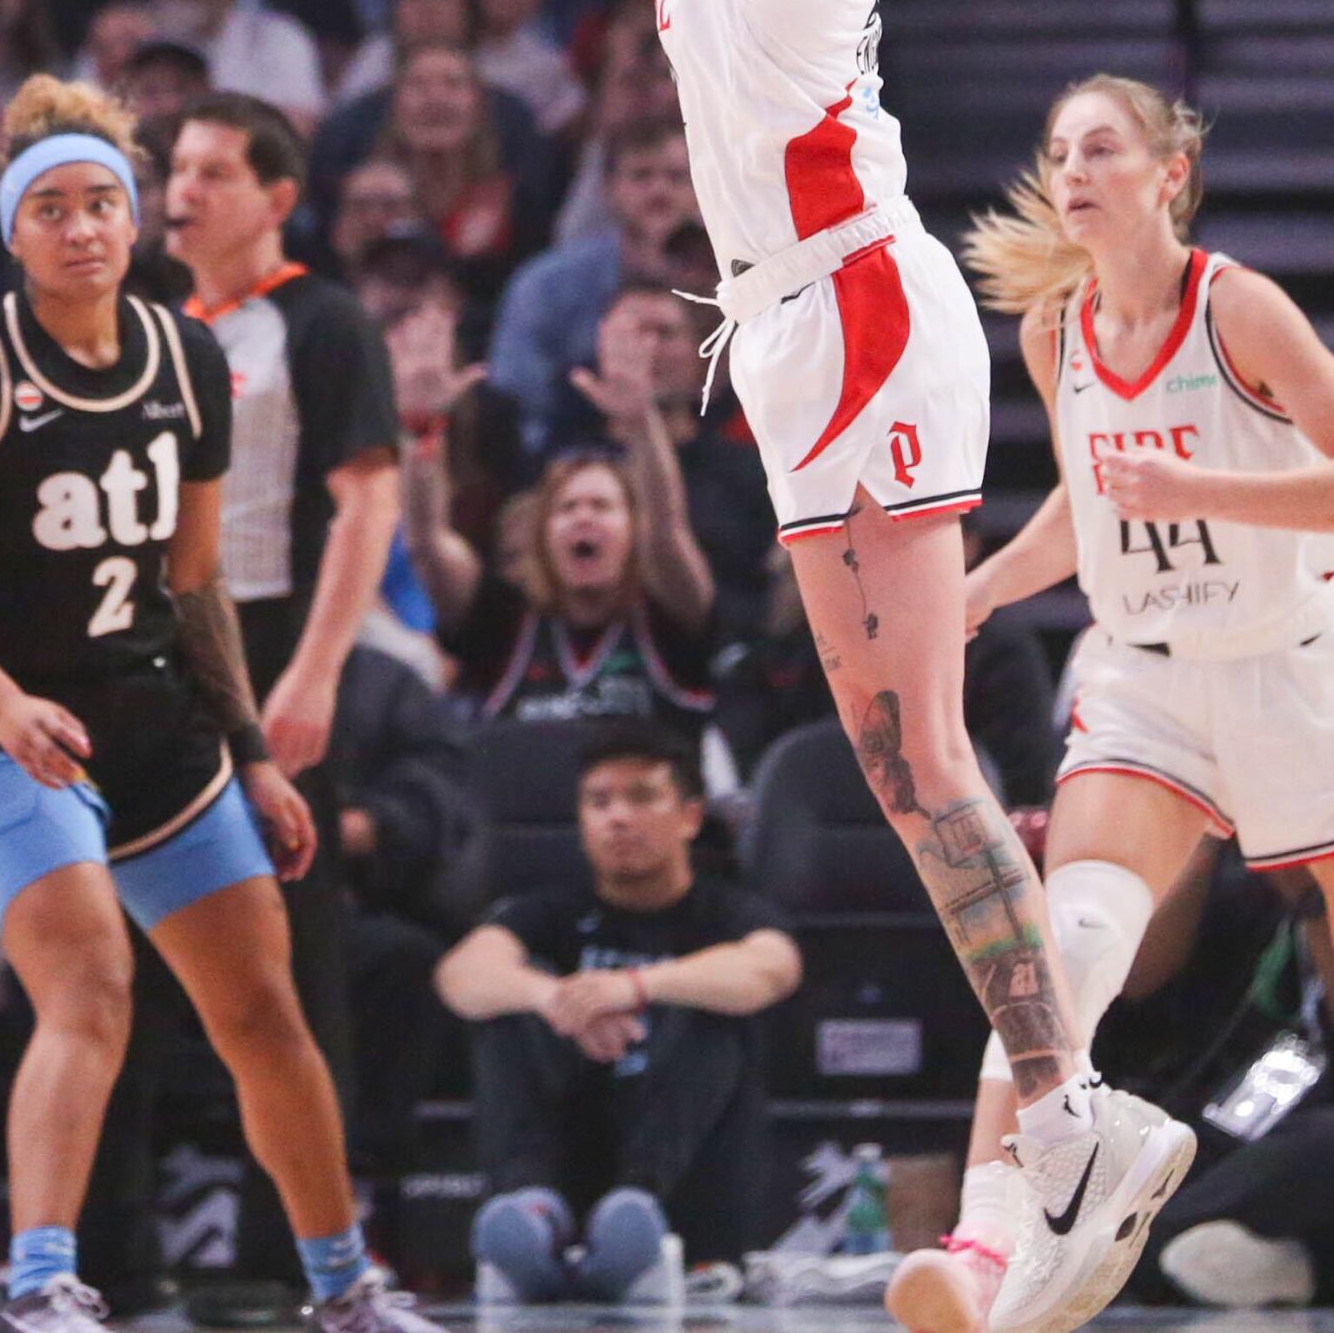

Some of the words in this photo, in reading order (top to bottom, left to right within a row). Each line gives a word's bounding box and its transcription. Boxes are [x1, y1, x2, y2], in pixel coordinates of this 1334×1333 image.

[32, 430, 181, 551] atl
[1119, 519, 1223, 574] 44
[87, 555, 138, 638] 2
